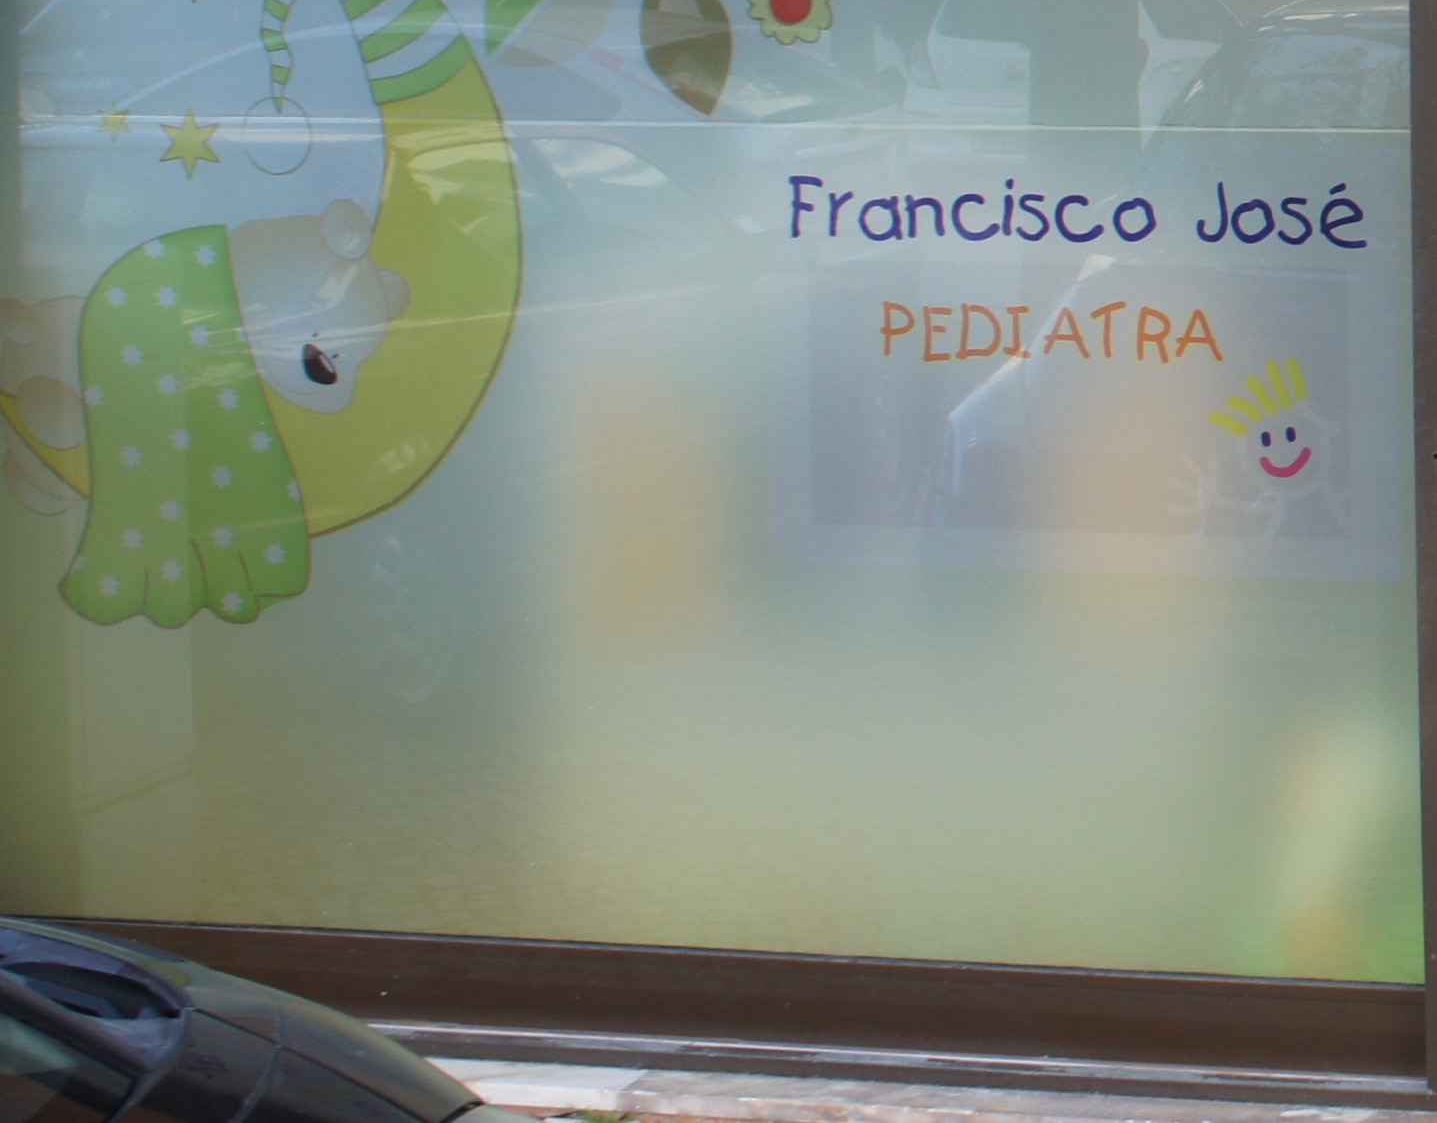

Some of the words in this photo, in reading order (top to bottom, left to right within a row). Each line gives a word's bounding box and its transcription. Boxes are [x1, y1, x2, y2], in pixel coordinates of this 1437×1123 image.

[788, 175, 1156, 244] Francisco
[1197, 181, 1369, 249] José
[880, 300, 1223, 364] PEDIATRA
